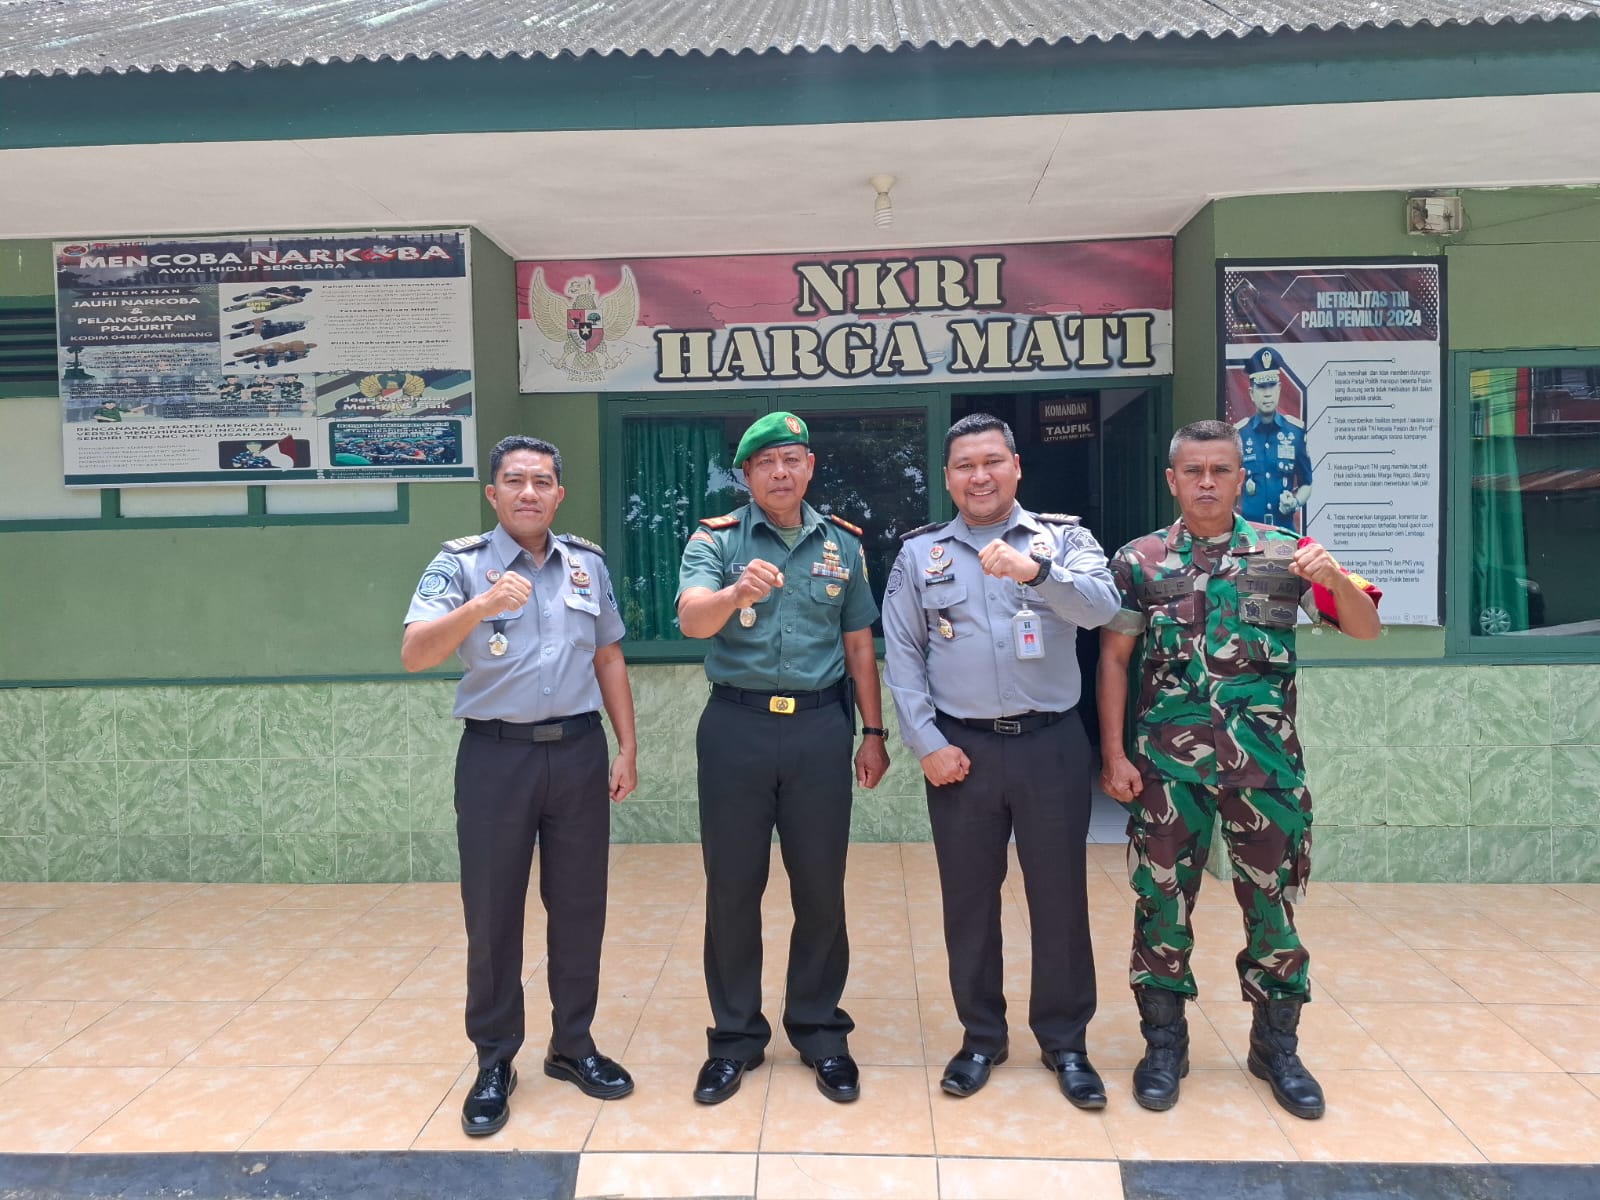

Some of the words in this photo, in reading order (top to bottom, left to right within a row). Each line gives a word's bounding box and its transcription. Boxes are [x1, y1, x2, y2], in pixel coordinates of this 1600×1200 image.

[80, 252, 243, 269] MENCOBA
[209, 265, 258, 273] HIDUP
[263, 263, 346, 271] SENGSARA
[798, 255, 1005, 315] NKRI
[92, 288, 181, 297] PENEKANAN
[72, 300, 117, 308] JAUHI
[121, 297, 201, 306] NARKOBA
[1316, 290, 1388, 309] NETRALITAS
[1390, 290, 1410, 308] TNI
[77, 314, 197, 325] PELANGGARAN
[1301, 310, 1335, 329] PADA
[1336, 309, 1384, 328] PEMILU
[1387, 309, 1422, 327] 2024
[101, 323, 175, 332] PRAJURIT
[70, 334, 109, 342] KODIM
[652, 320, 932, 384] HARGA
[947, 312, 1156, 374] MATI
[1044, 402, 1088, 417] KOMANDAN
[1045, 423, 1092, 436] TAUFIK
